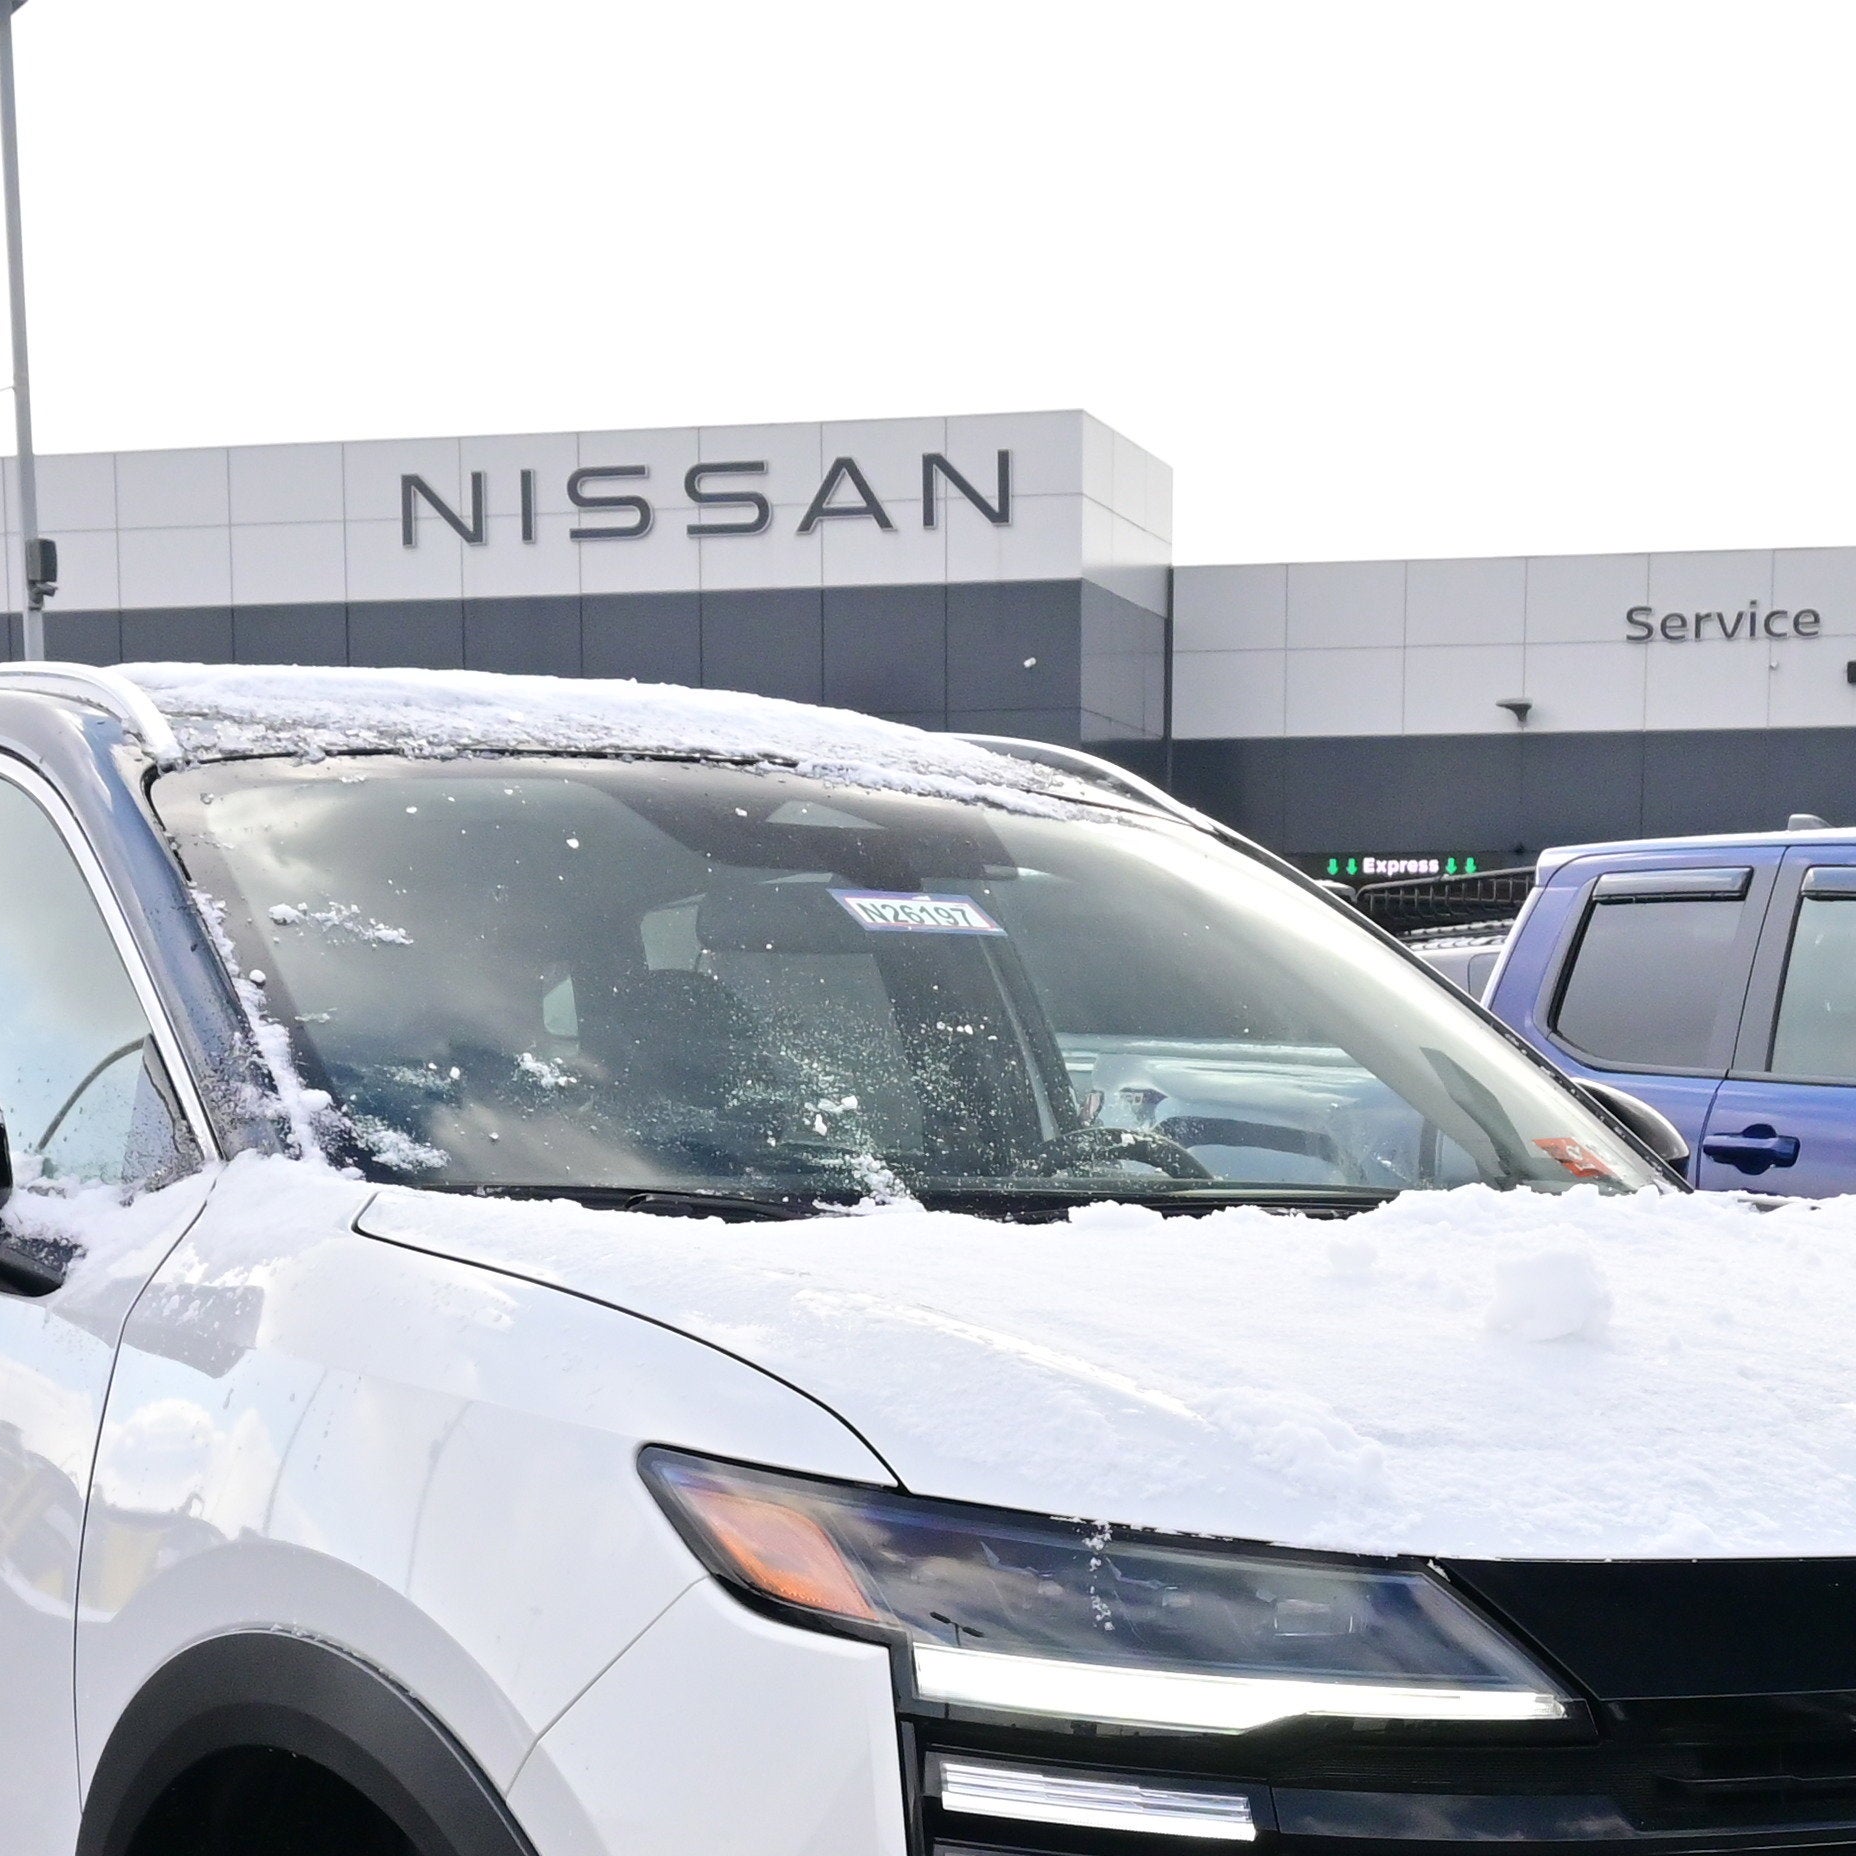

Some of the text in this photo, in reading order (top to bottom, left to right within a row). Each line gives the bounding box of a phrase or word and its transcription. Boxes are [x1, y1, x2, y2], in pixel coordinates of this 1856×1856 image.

[400, 449, 1012, 548] NISSAN
[1626, 599, 1821, 643] Service
[1361, 857, 1440, 877] Express
[857, 902, 973, 927] N26197
